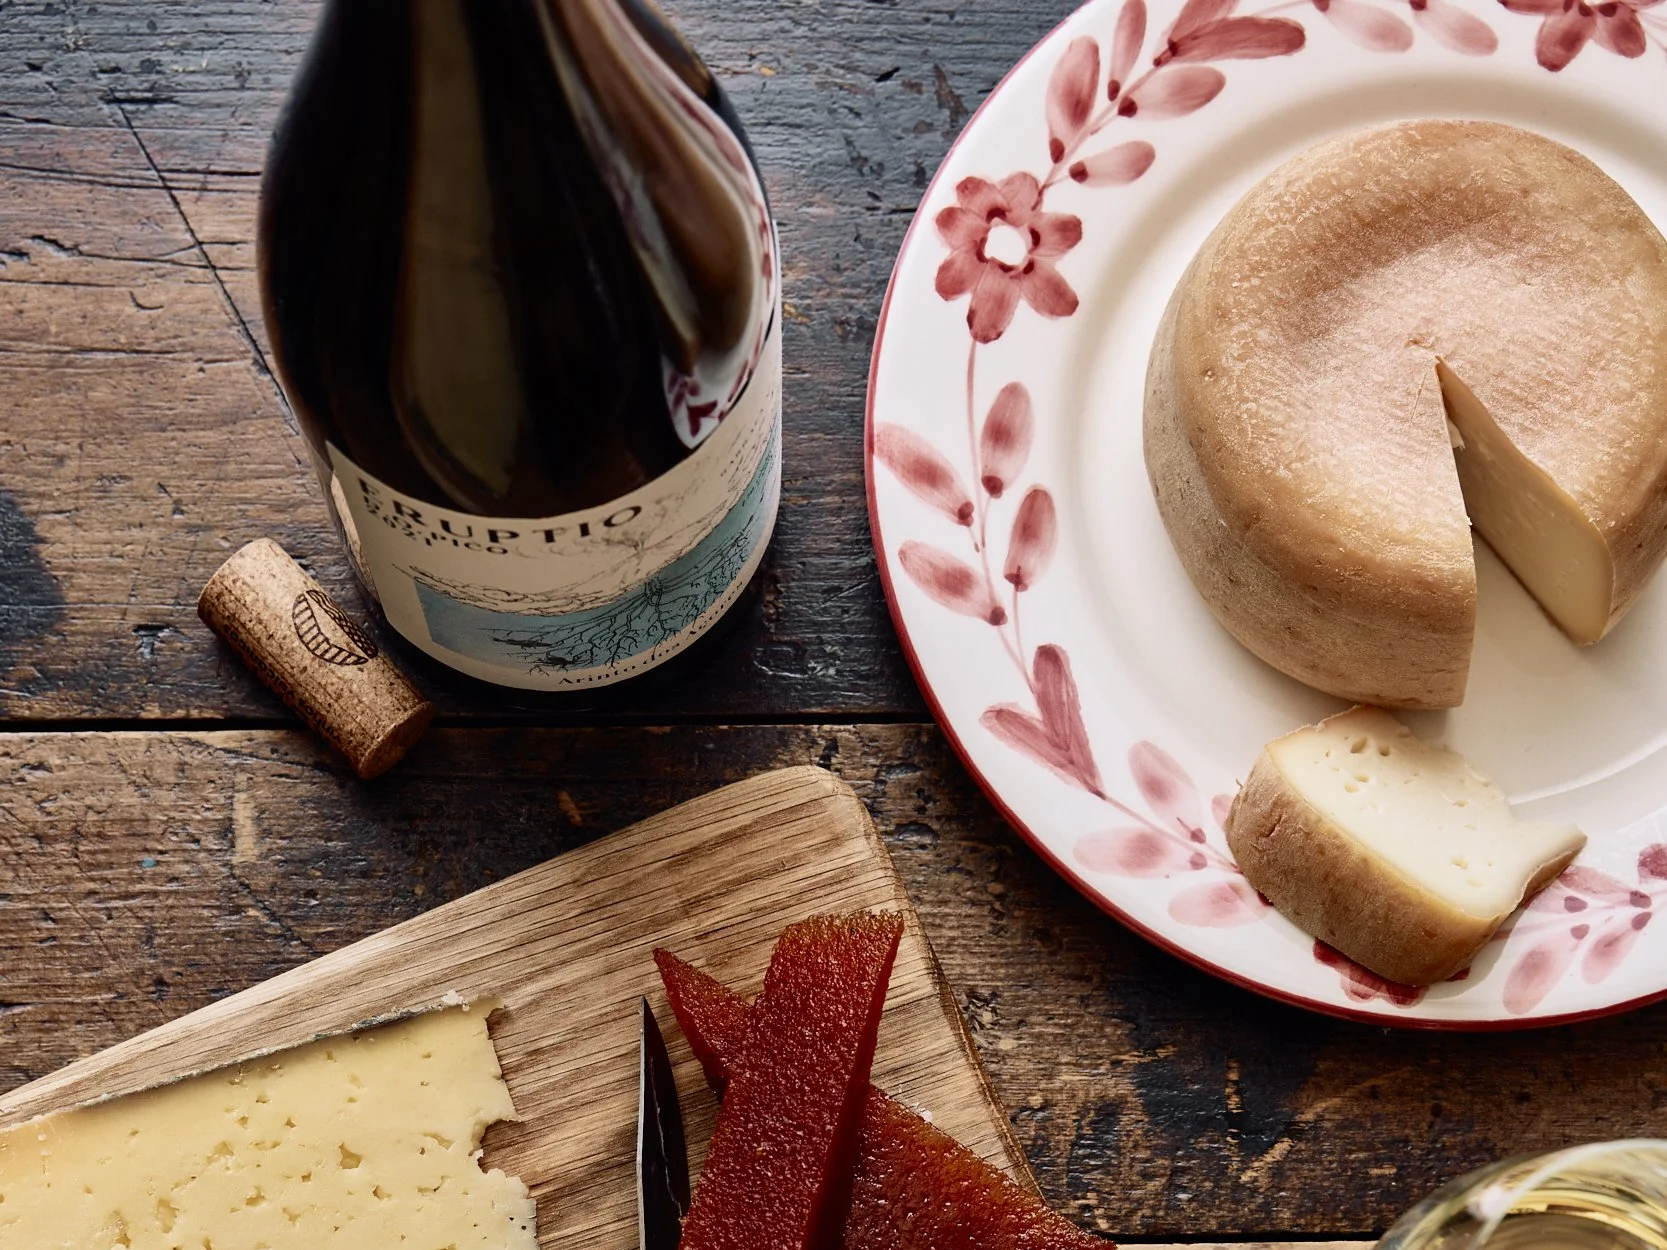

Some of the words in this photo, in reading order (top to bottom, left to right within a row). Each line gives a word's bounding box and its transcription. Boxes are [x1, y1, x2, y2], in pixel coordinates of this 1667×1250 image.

[358, 477, 642, 544] ERUPTIO
[558, 664, 636, 685] Arinto
[642, 642, 681, 665] dos
